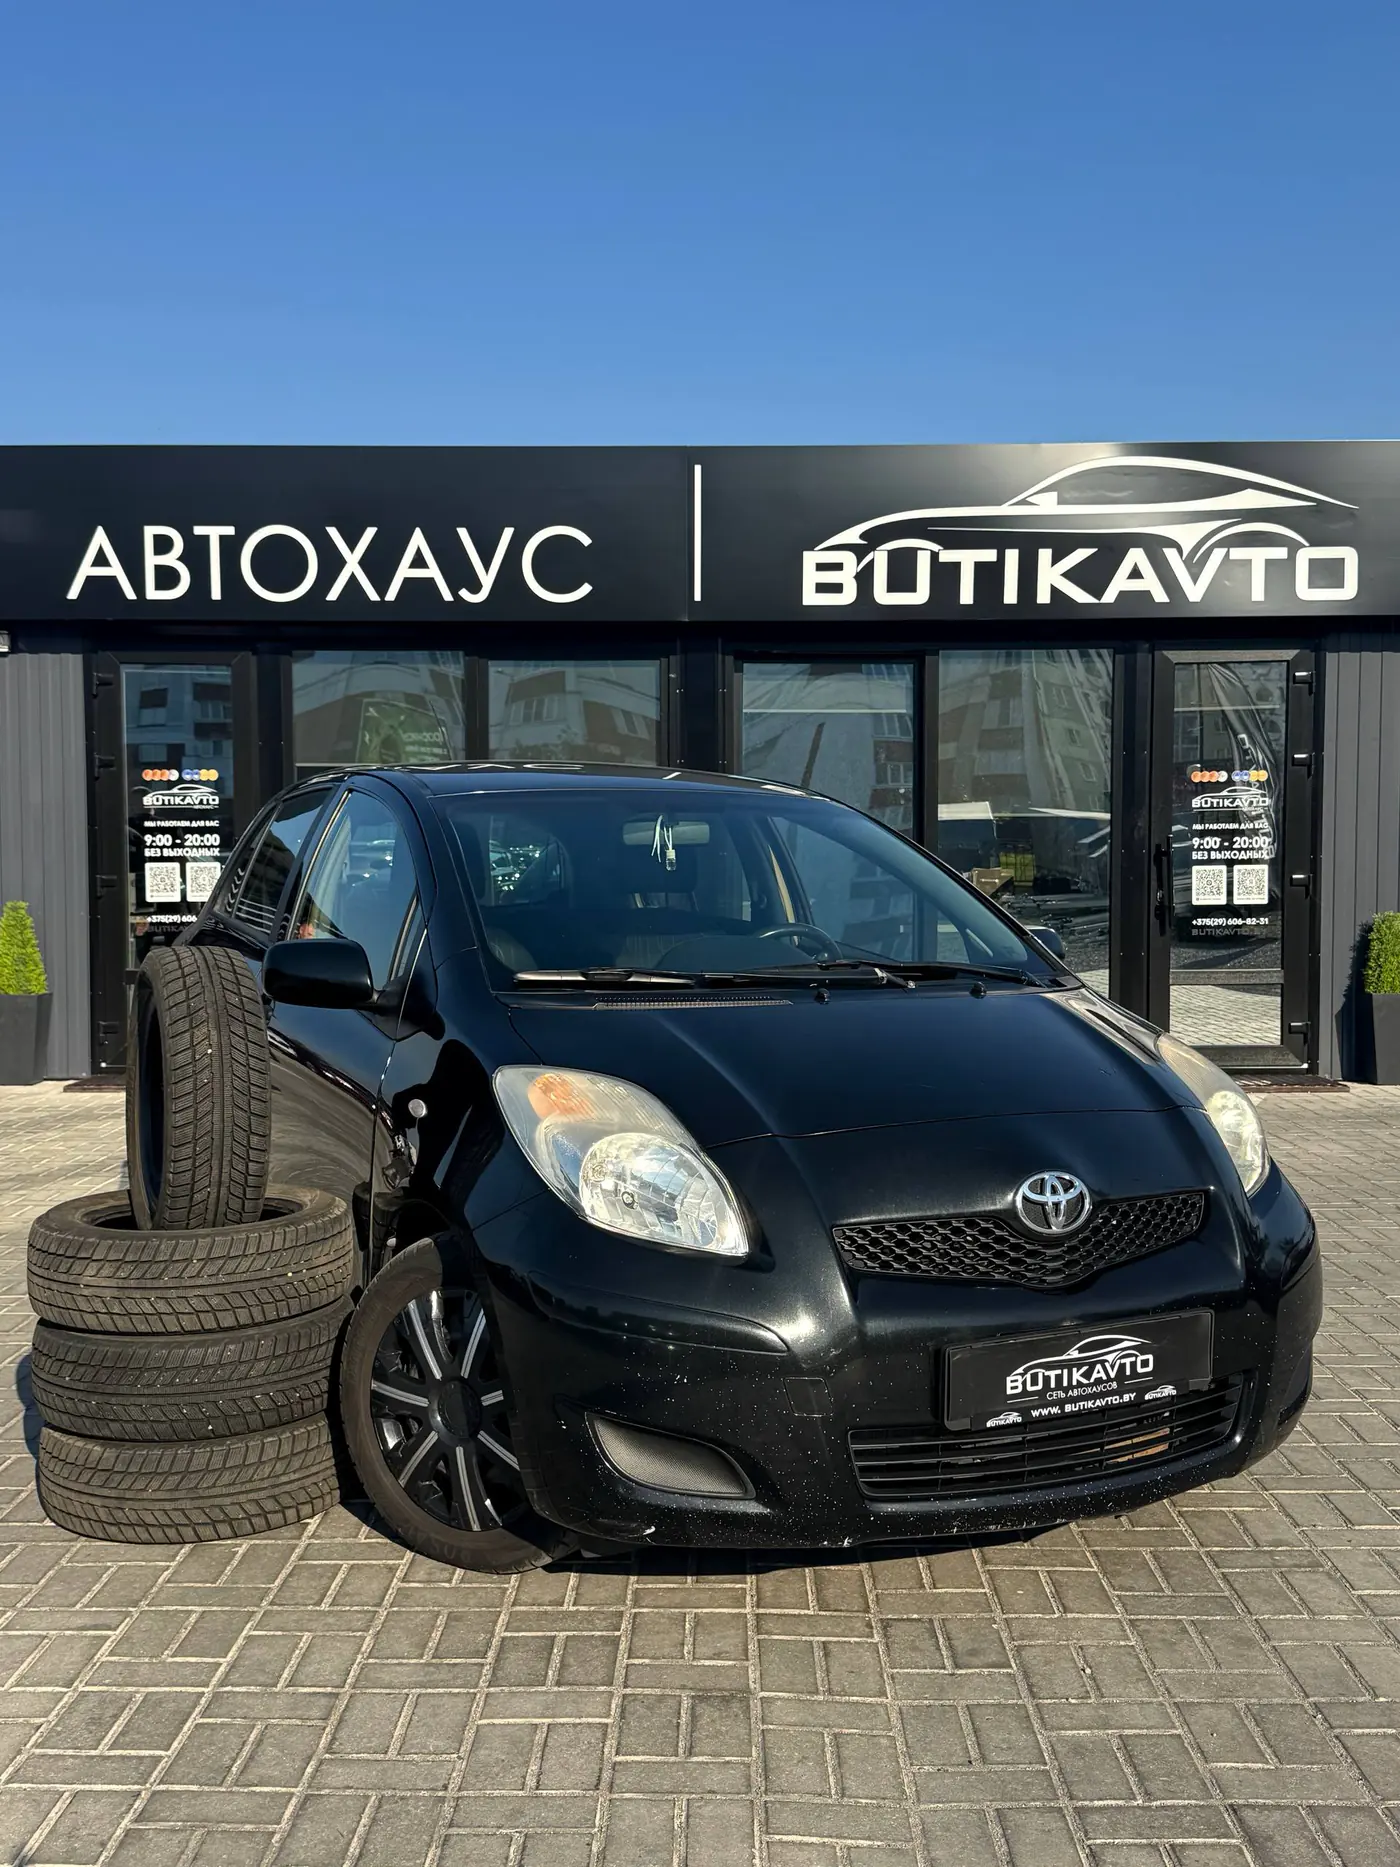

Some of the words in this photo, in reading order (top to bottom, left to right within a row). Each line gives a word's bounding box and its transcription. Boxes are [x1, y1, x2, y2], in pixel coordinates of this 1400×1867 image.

[66, 525, 593, 603] АВТОХАУС
[802, 545, 1359, 606] BUTIKAVTO
[143, 795, 220, 805] BUTIKAVTO
[1192, 797, 1269, 808] BUTIKAVTO
[205, 820, 220, 828] ВАС
[1240, 822, 1254, 830] ДЛЯ
[1254, 822, 1269, 830] ВАС
[144, 834, 172, 847] 9:00
[184, 834, 220, 847] 20:00
[1192, 837, 1220, 849] 9:00
[1232, 836, 1269, 849] 20:00
[144, 848, 161, 857] БЕЗ
[163, 847, 220, 858] ВЫХОДНЫХ
[1192, 851, 1208, 860] БЕЗ
[1210, 850, 1268, 860] ВЫХОДНЫХ
[1192, 918, 1226, 926] +375(29)
[1227, 917, 1269, 926] 606-82-31
[1006, 1353, 1154, 1395] BUTIKAVTO
[1046, 1389, 1066, 1401] СЕТЬ
[1067, 1381, 1118, 1398] АВТОХАУСОВ
[1144, 1389, 1177, 1400] BUTIKAVTO
[1030, 1405, 1062, 1418] WWW.
[1064, 1392, 1137, 1413] BUTIKAVTO.BY
[986, 1415, 1023, 1428] BUTIKAVTO
